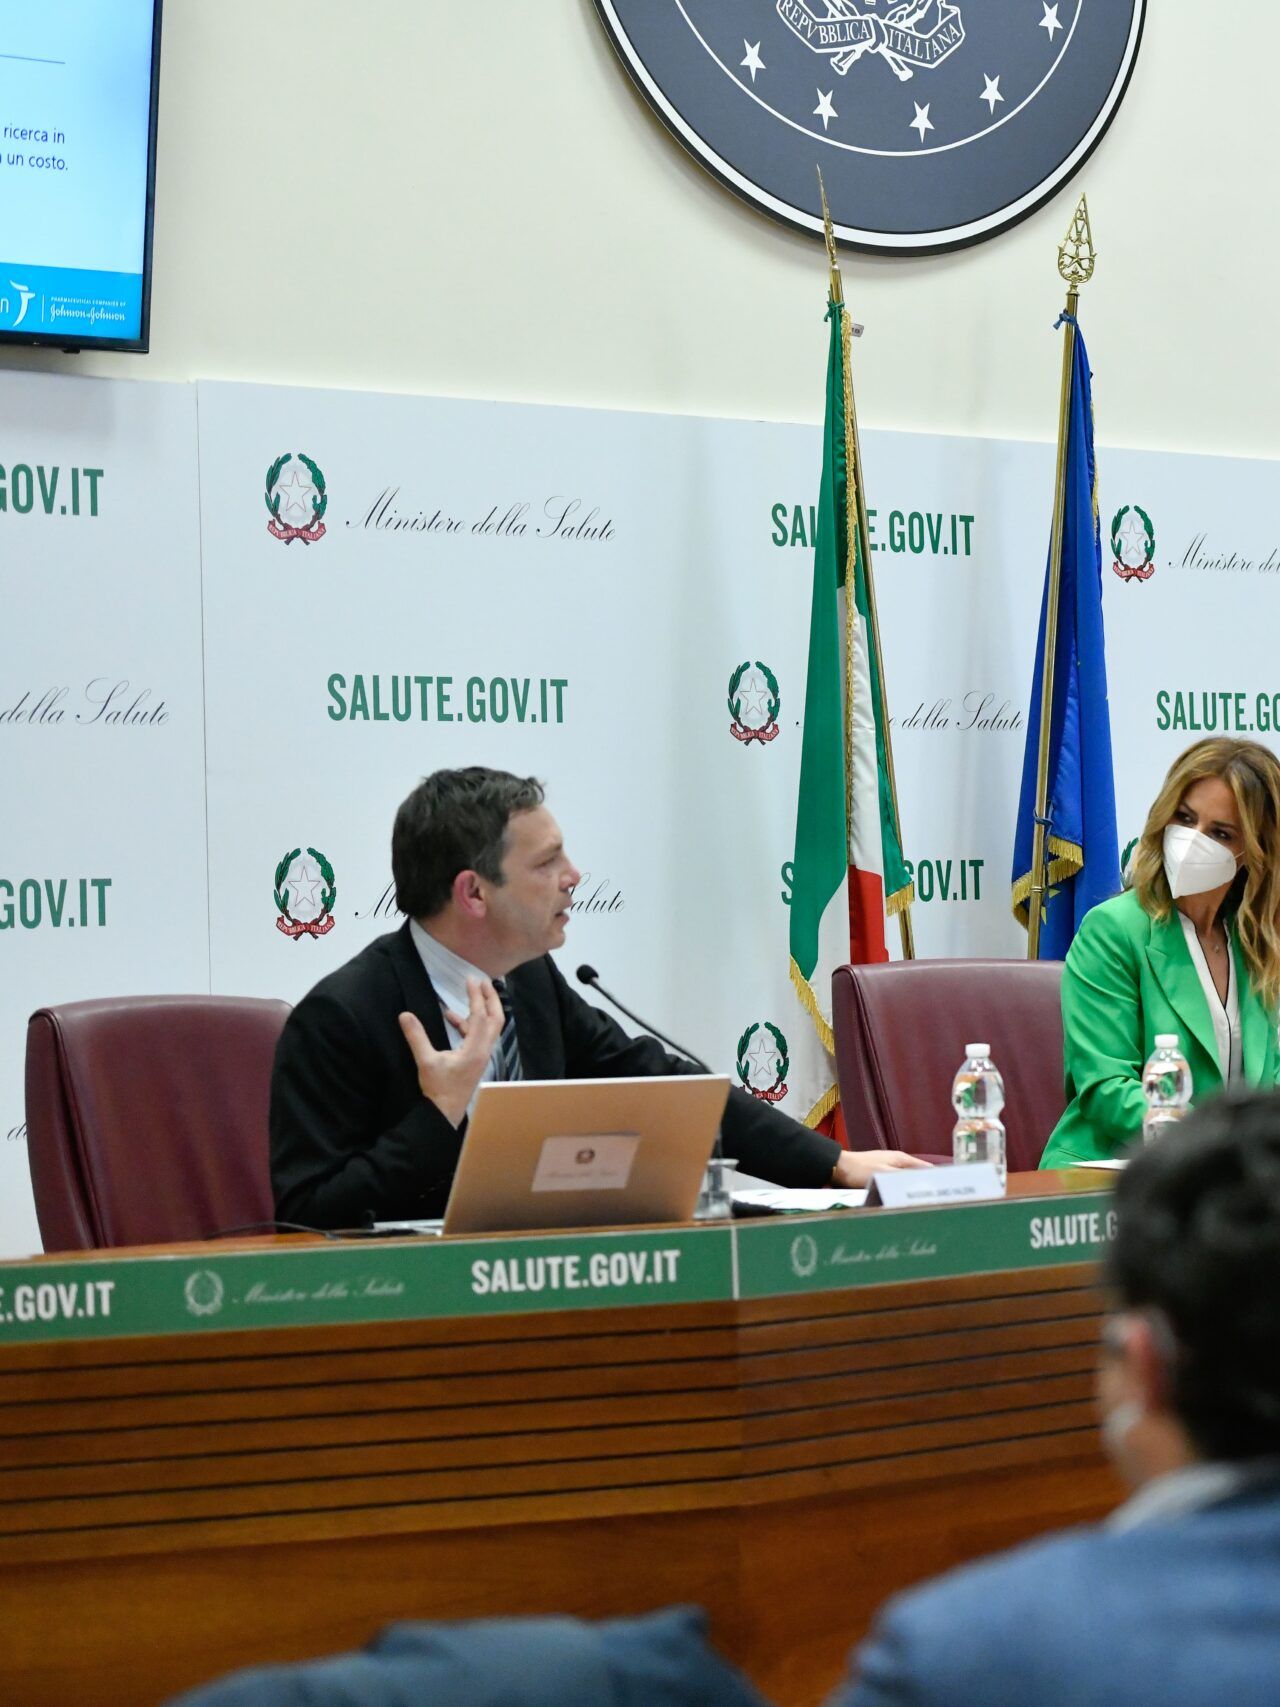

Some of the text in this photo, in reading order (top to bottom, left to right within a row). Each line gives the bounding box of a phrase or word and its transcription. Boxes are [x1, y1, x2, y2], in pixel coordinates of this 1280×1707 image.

[780, 0, 962, 61] REPVBBLICA ITALIANA
[4, 123, 65, 144] ricerca in
[7, 154, 24, 166] un
[29, 154, 68, 171] costo.
[345, 486, 617, 542] Ministero della Salute
[771, 502, 975, 556] SALE.GOV.IT
[1168, 532, 1254, 572] Ministero
[0, 676, 169, 726] della Salute
[327, 672, 568, 724] SALUTE.GOV.IT
[901, 690, 1025, 732] della Salute
[1030, 1210, 1118, 1249] SALUTE.G
[471, 1249, 681, 1295] SALUTE.GOV.IT
